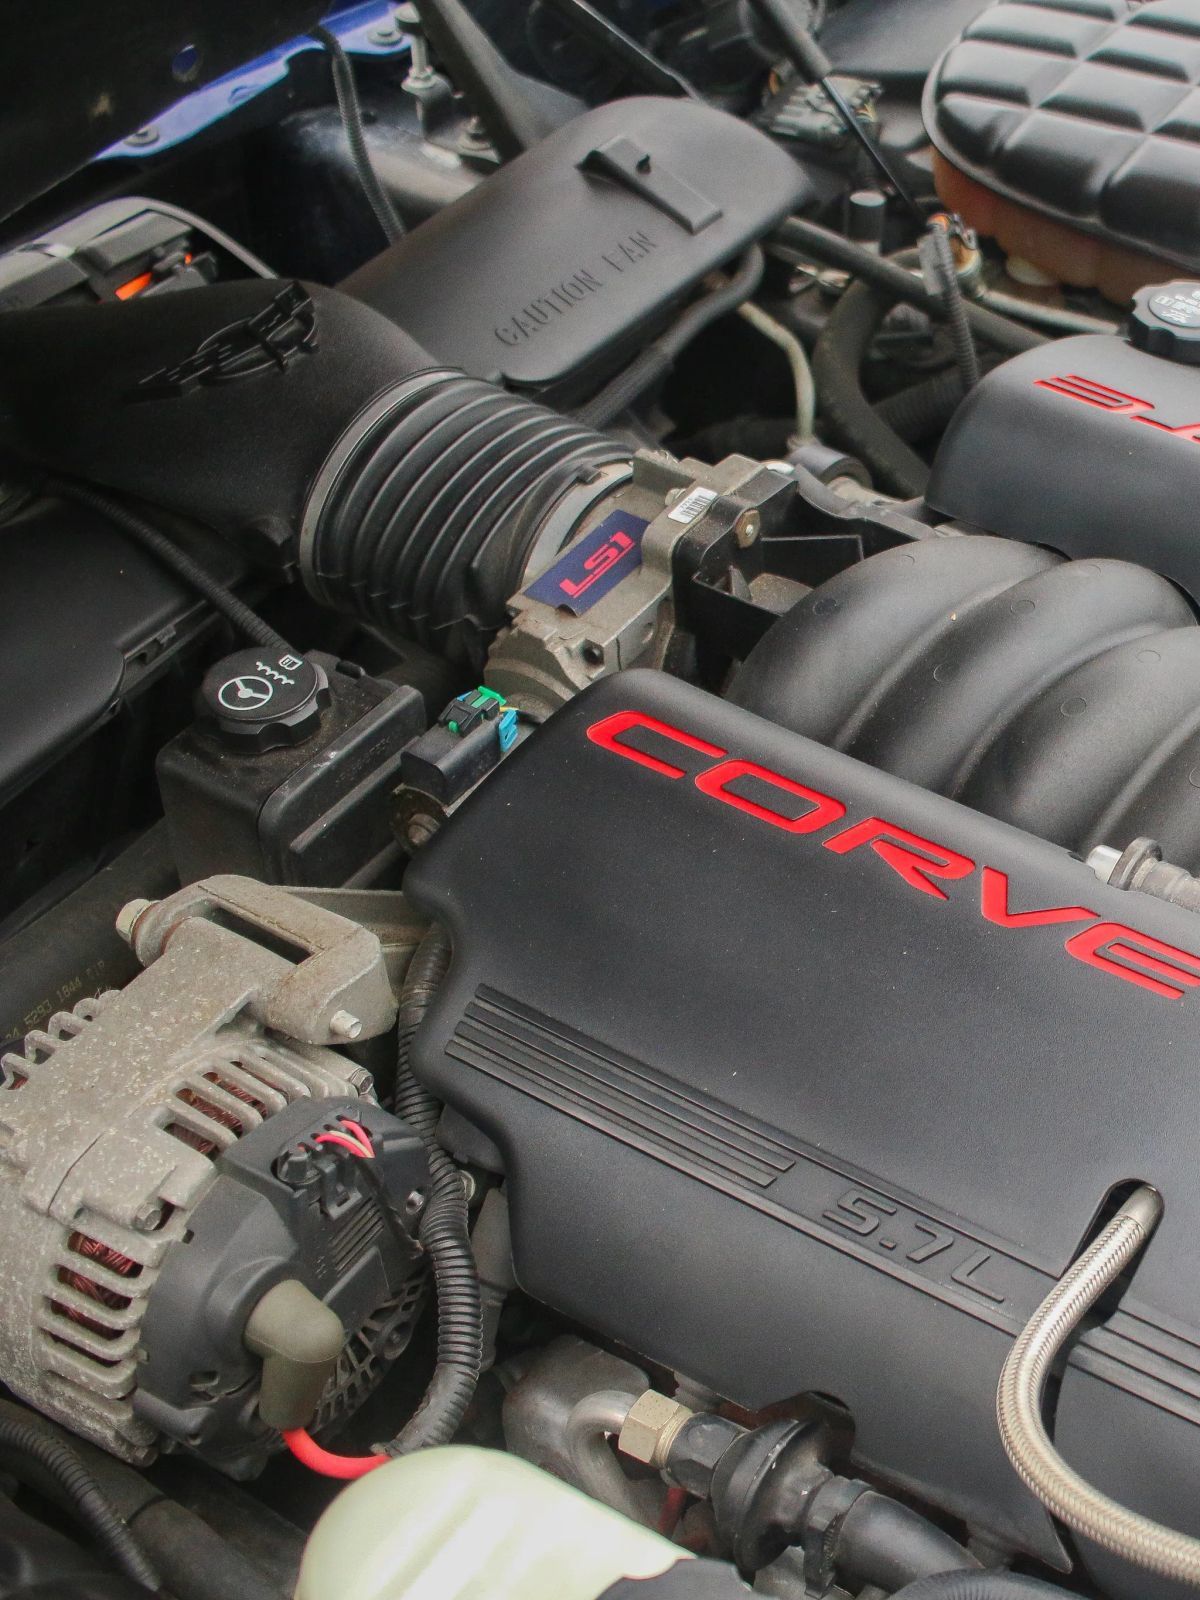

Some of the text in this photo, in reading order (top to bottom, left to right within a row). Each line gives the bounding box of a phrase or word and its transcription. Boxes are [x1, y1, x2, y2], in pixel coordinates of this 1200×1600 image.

[494, 231, 658, 346] CAUTION FAN
[559, 531, 635, 599] LS1
[822, 1188, 1005, 1304] 5.7L
